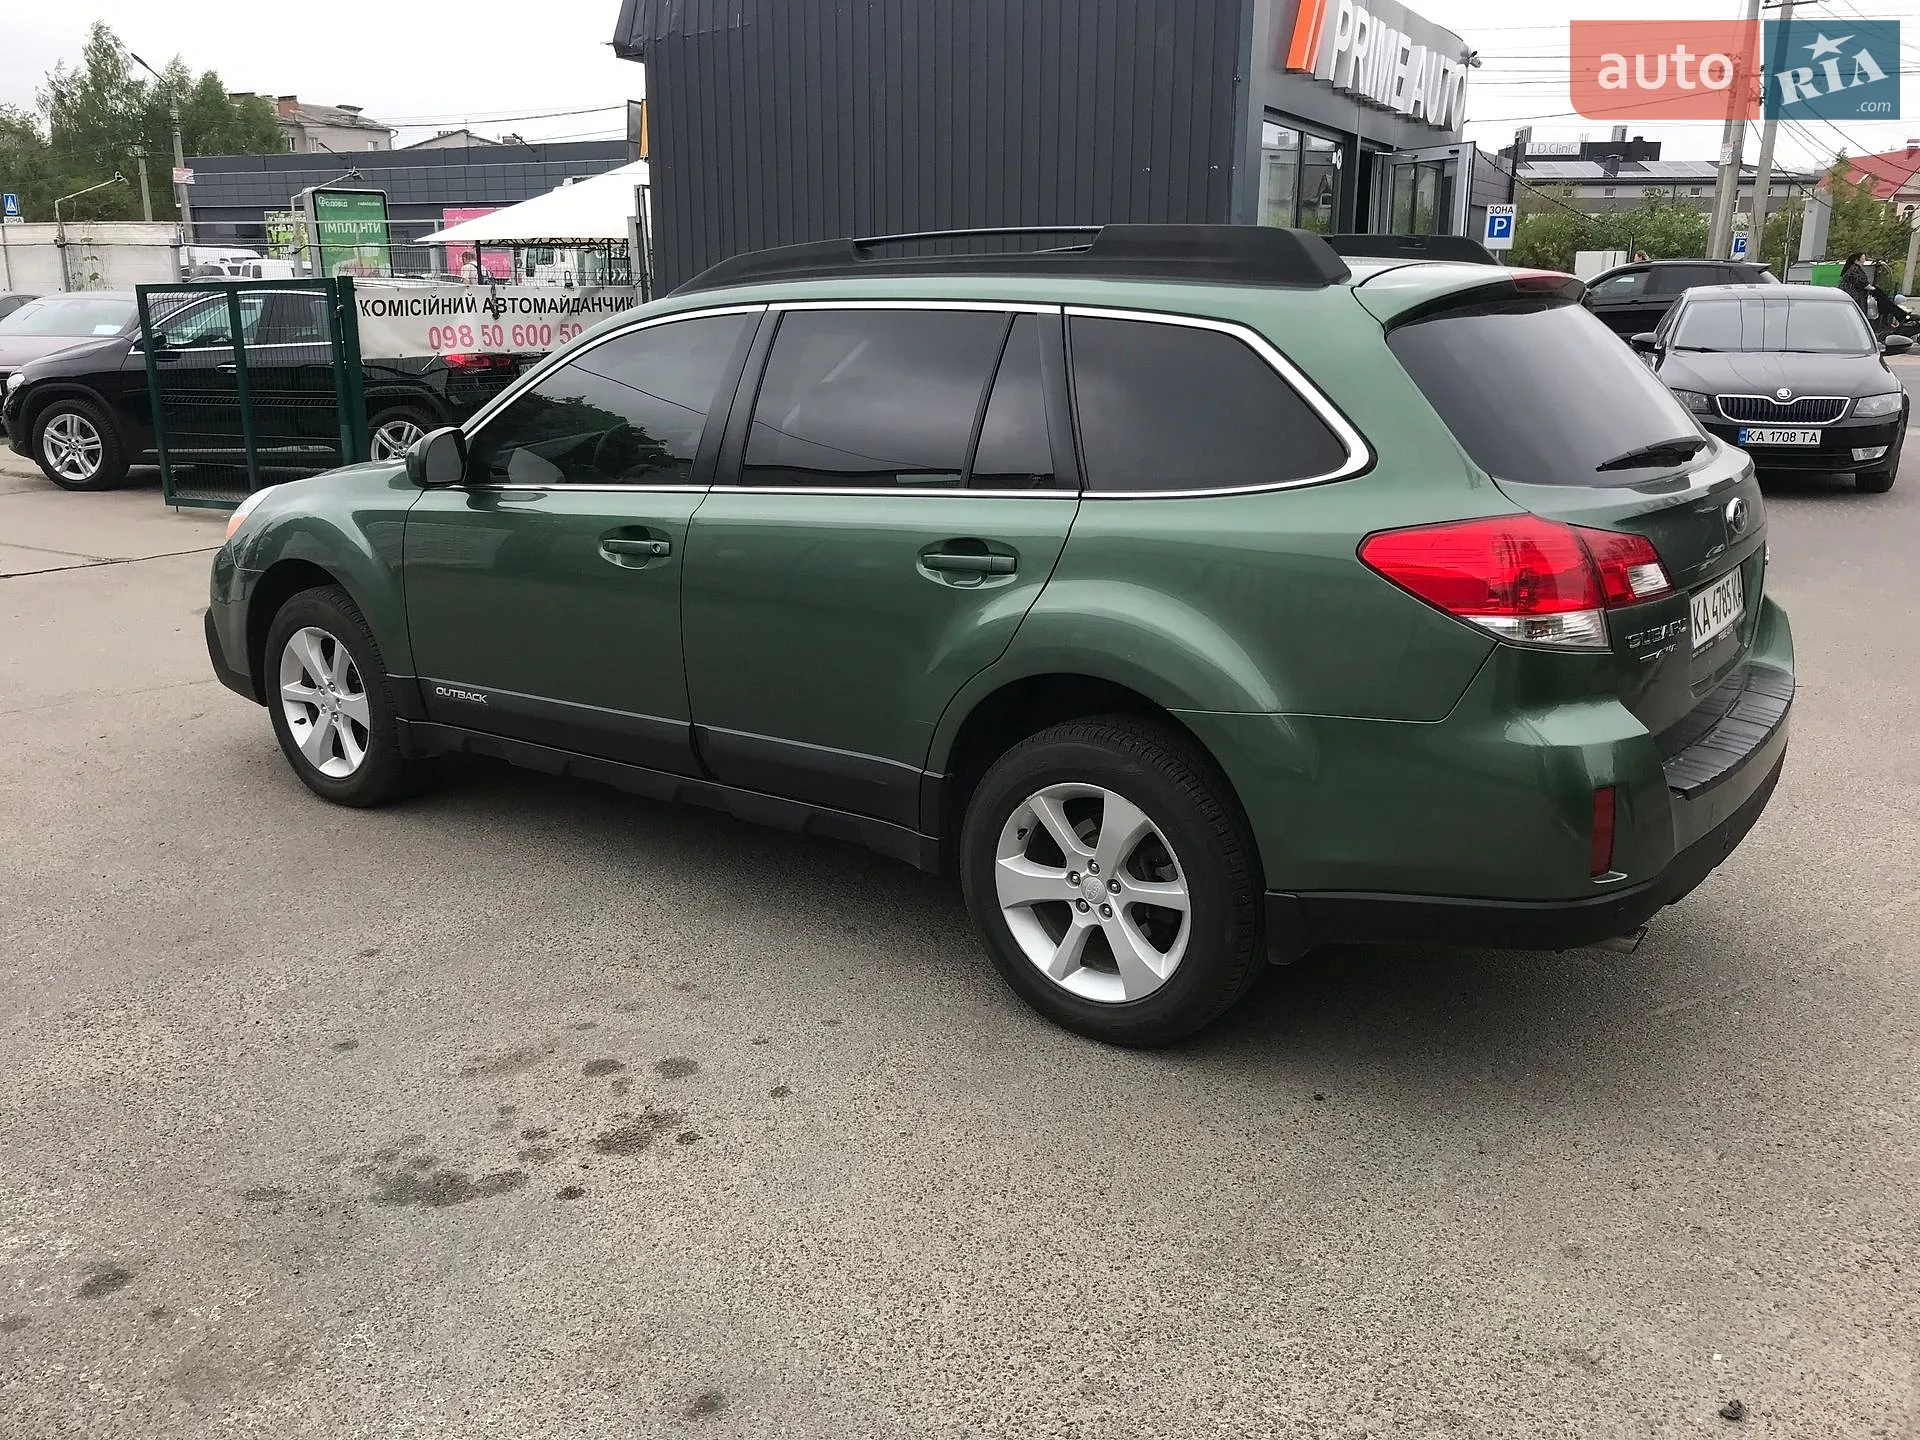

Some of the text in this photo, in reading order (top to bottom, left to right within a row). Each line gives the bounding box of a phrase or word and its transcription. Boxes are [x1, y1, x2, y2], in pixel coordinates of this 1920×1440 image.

[1489, 206, 1514, 214] ЗОНА
[359, 293, 634, 317] КОМІСІЙНИЙ АВТОМАЙДАНЧИК
[429, 323, 474, 350] 098
[480, 323, 504, 347] 50
[512, 323, 551, 347] 600
[1746, 430, 1765, 442] KA
[1769, 431, 1797, 443] 1708
[1800, 431, 1818, 443] TA
[1692, 596, 1711, 641] KA
[1712, 578, 1732, 625] 4785
[435, 686, 488, 704] OUTBACK
